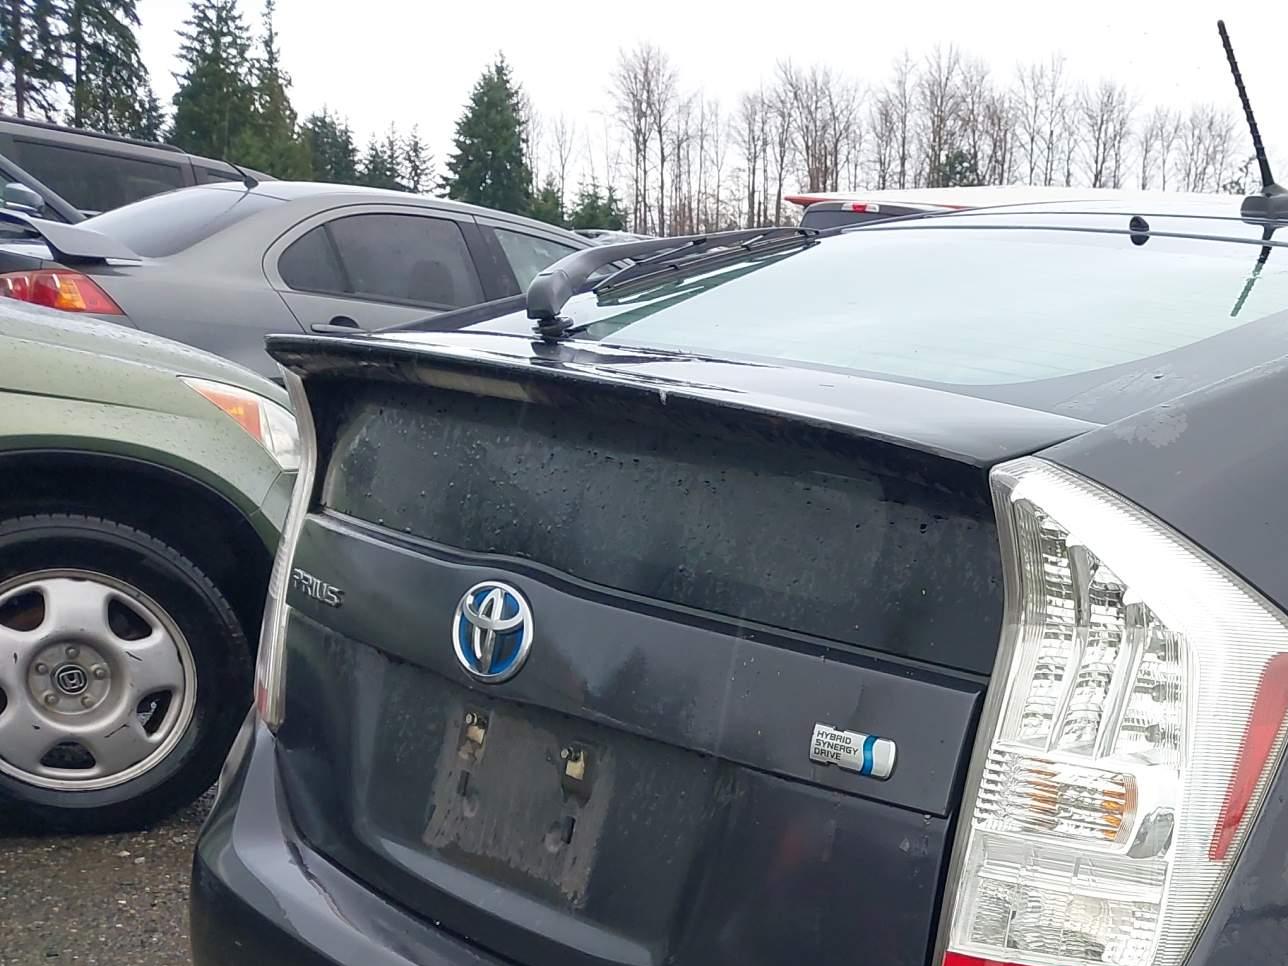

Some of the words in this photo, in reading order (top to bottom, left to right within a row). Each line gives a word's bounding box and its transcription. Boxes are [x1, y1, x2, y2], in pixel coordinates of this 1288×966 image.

[292, 567, 343, 607] PRIUS
[816, 729, 852, 745] HYBRID
[813, 747, 842, 761] DRIVE
[814, 738, 859, 756] SYNERGY
